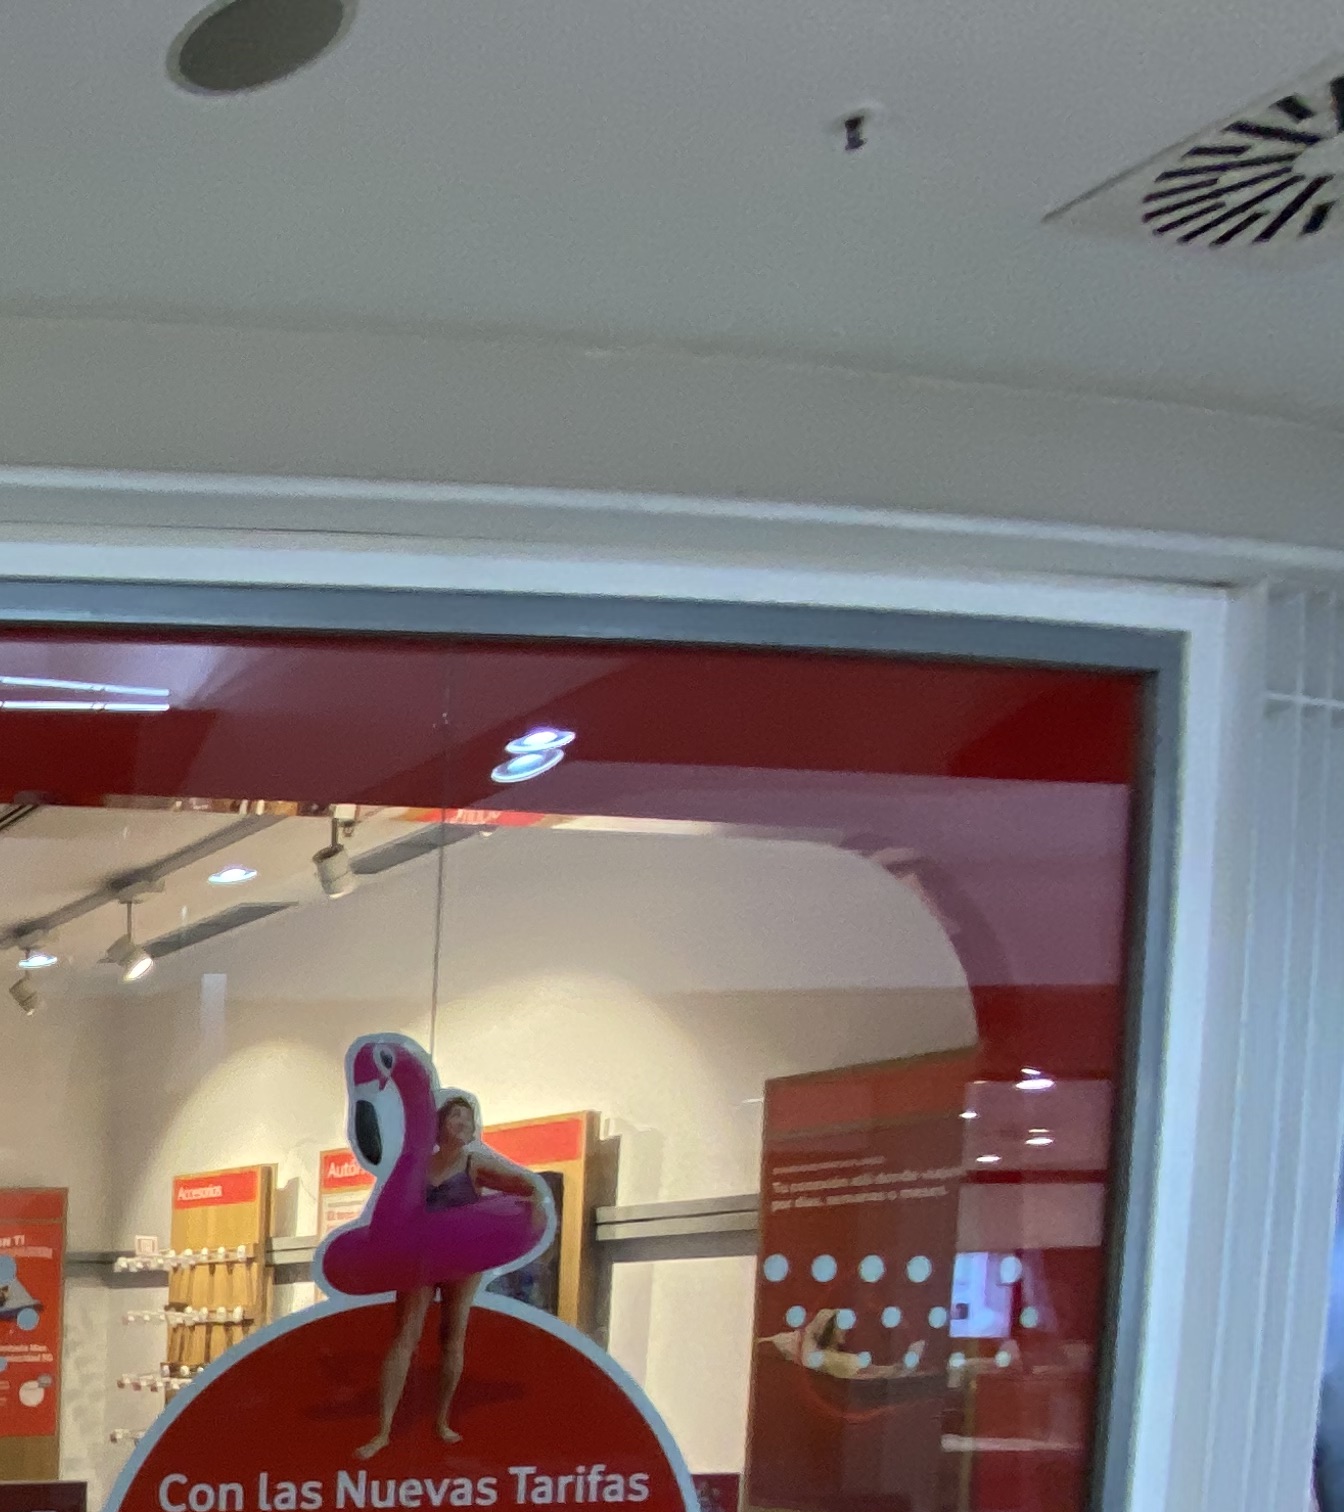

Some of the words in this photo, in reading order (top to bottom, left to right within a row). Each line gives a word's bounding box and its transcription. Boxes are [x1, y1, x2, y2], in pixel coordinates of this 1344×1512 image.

[258, 1472, 323, 1512] las
[336, 1470, 499, 1510] Nuevas
[508, 1464, 650, 1506] Tarifas
